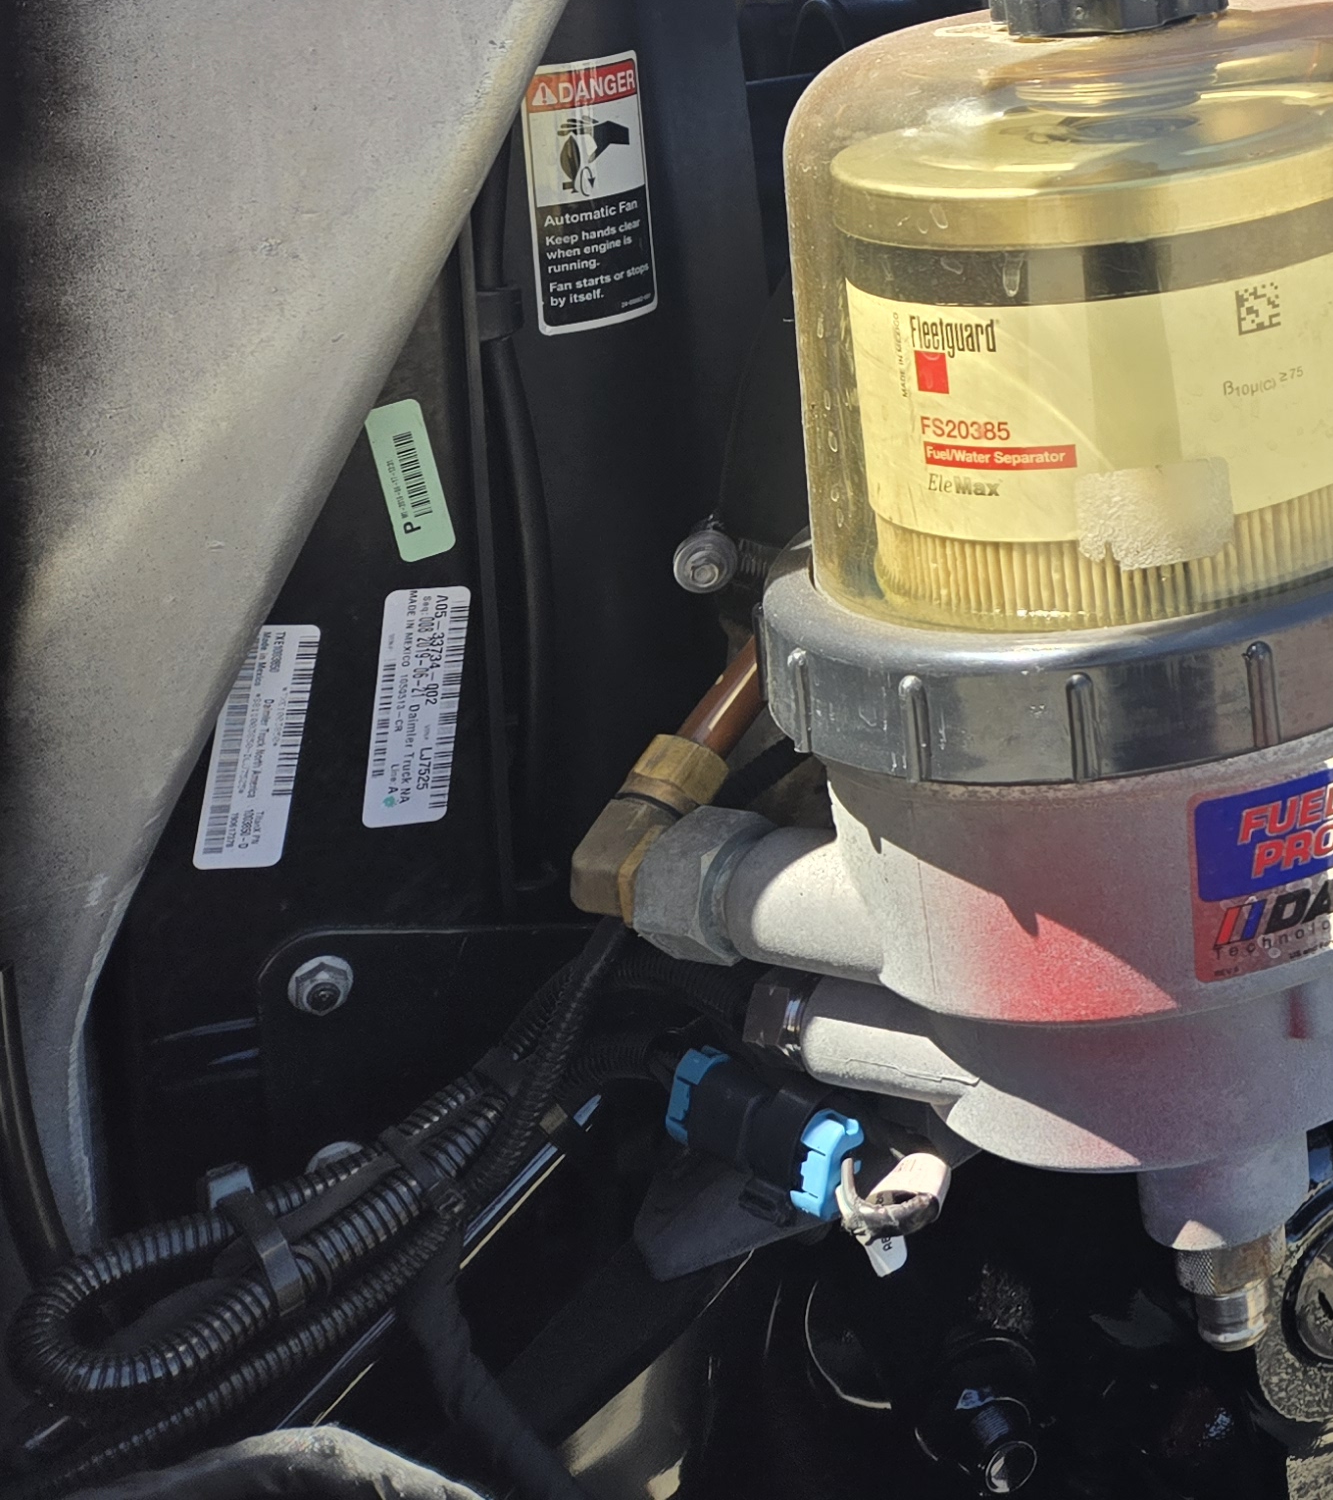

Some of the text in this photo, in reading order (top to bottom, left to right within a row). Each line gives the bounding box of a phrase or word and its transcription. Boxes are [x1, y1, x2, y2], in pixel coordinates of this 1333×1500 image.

[558, 69, 636, 103] DANGER
[544, 200, 638, 227] Automatic Fan
[545, 219, 641, 246] Keep hands clear
[546, 235, 633, 260] when engine is
[547, 258, 600, 274] running.
[549, 263, 650, 293] Fan starts or stops
[550, 296, 566, 308] by
[569, 288, 605, 304] itself.
[909, 315, 997, 358] Fleetguard
[898, 355, 904, 366] IN
[900, 371, 908, 398] MADE
[920, 416, 1011, 441] FS20385
[926, 445, 1066, 466] Fuel/Water Separator
[403, 521, 422, 535] P
[406, 590, 418, 617] MADE
[406, 619, 415, 629] IN
[401, 632, 413, 667] MEXICO
[405, 704, 420, 748] Daimler
[400, 752, 415, 784] Truck
[416, 747, 433, 791] LJ7525
[388, 786, 399, 795] A
[398, 787, 411, 804] NA
